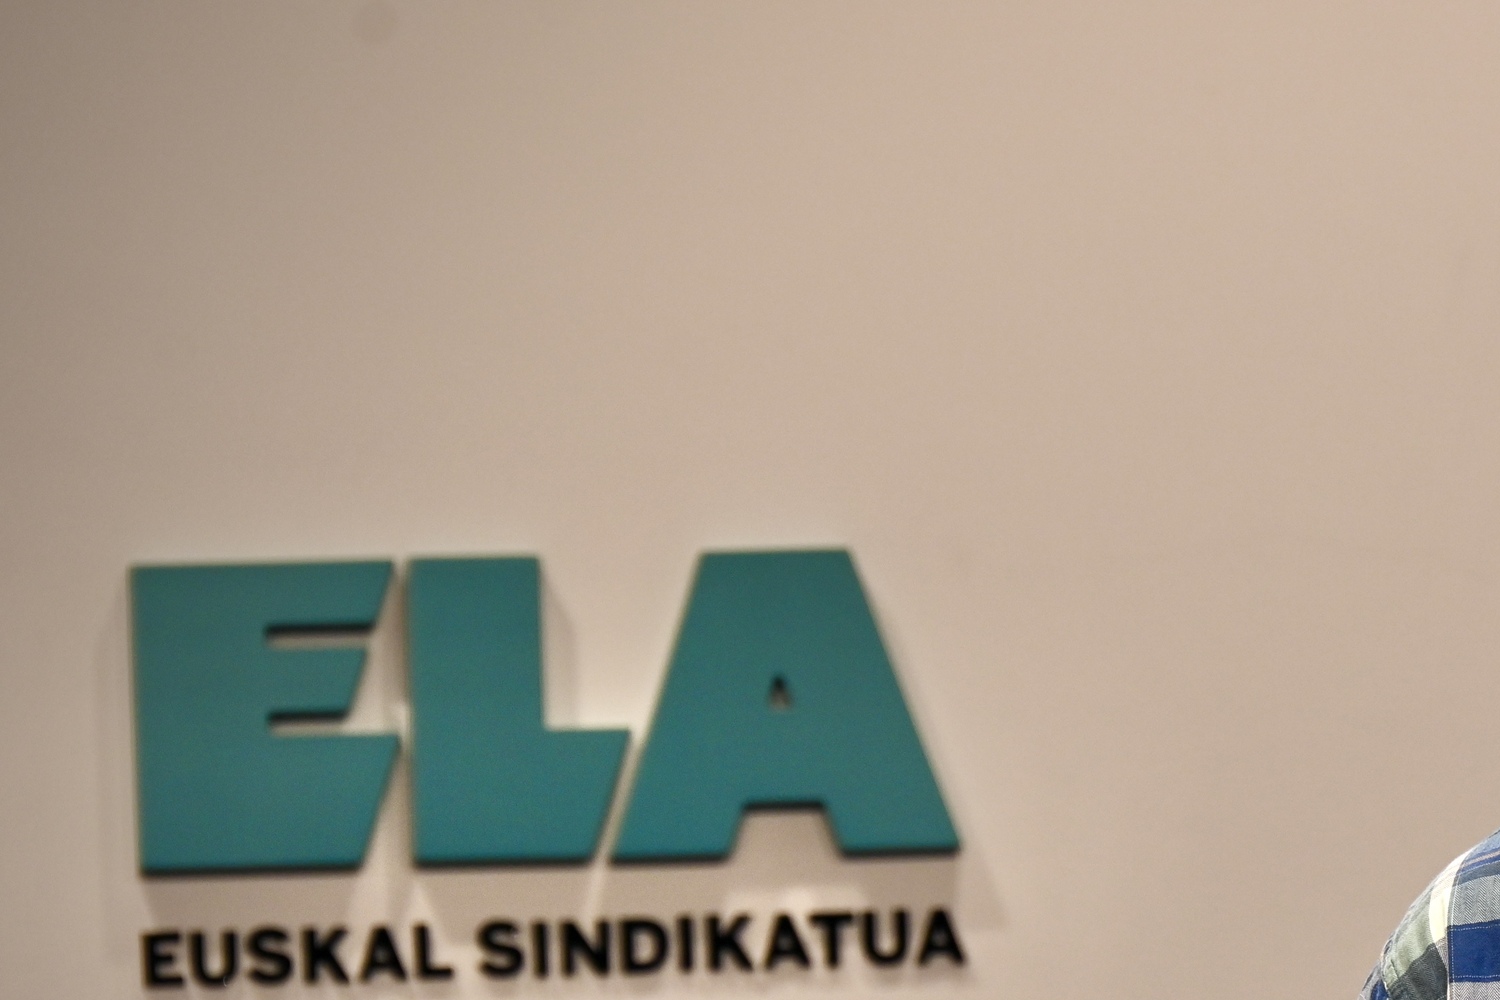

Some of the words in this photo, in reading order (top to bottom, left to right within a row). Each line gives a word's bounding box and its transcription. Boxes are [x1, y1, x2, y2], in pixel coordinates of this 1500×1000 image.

[129, 549, 961, 877] ELA
[142, 923, 453, 989] EUSKAL
[477, 908, 967, 979] SINDIKATUA
